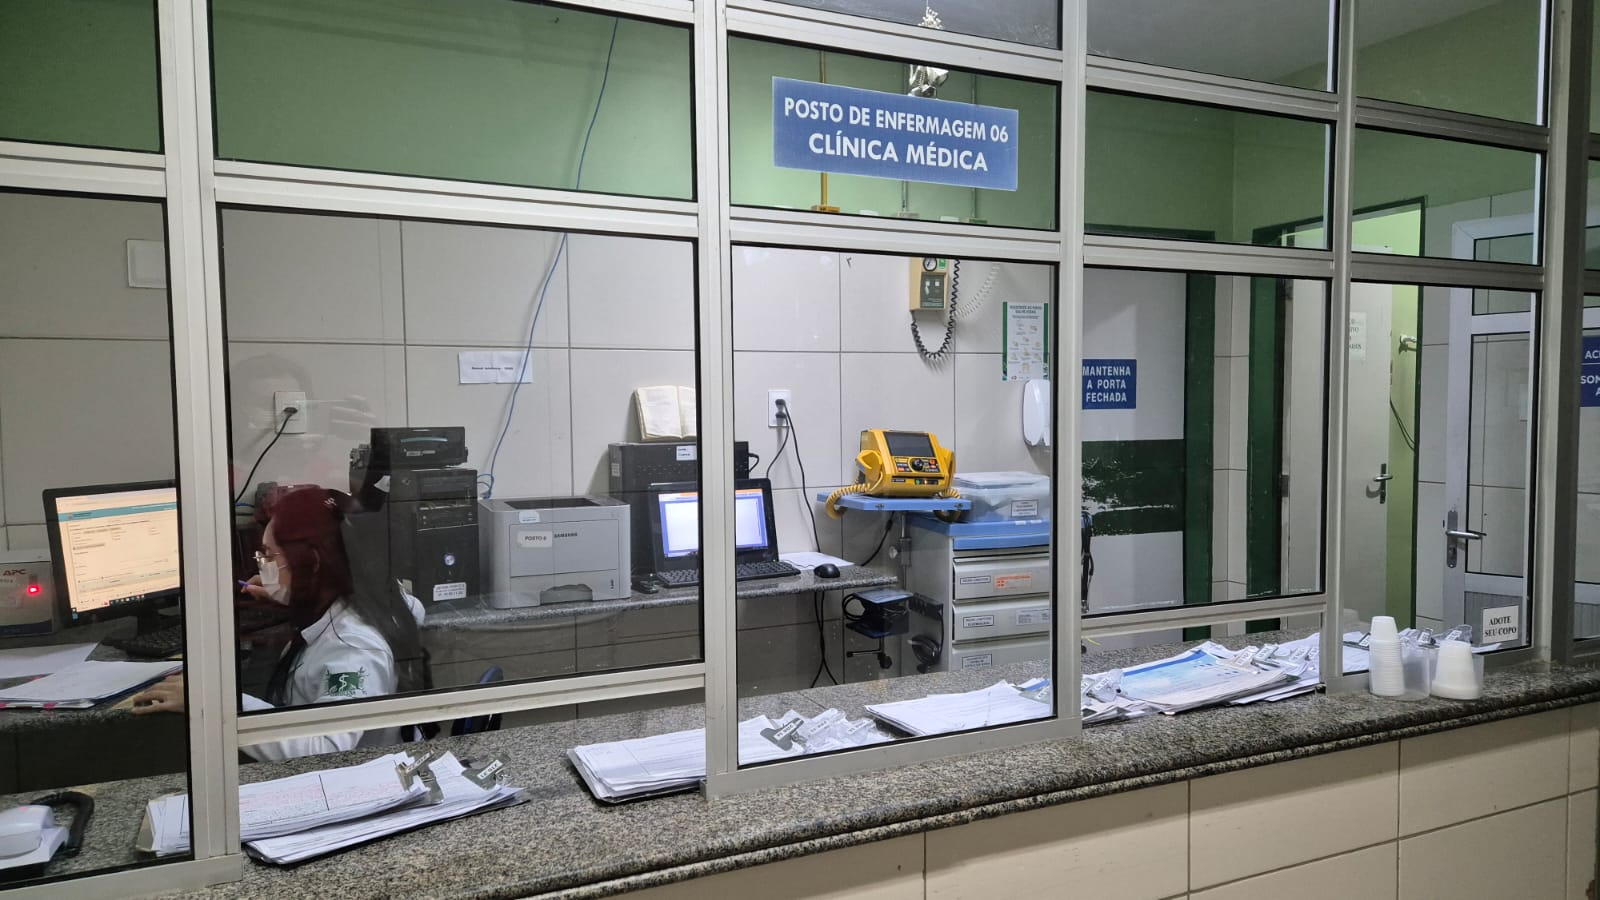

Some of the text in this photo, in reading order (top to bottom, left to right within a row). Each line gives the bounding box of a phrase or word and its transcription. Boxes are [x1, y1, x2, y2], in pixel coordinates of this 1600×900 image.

[784, 97, 1009, 143] POSTO DE ENFERMAGEM 06
[808, 130, 988, 172] CLÍNICA MÉDICA
[1585, 350, 1600, 359] AC
[1082, 366, 1131, 376] MANTENHA
[1087, 379, 1127, 389] A PORTA
[1086, 392, 1127, 402] FECHADA
[1489, 616, 1511, 625] ADOTE
[1484, 626, 1517, 637] SEU COPO
